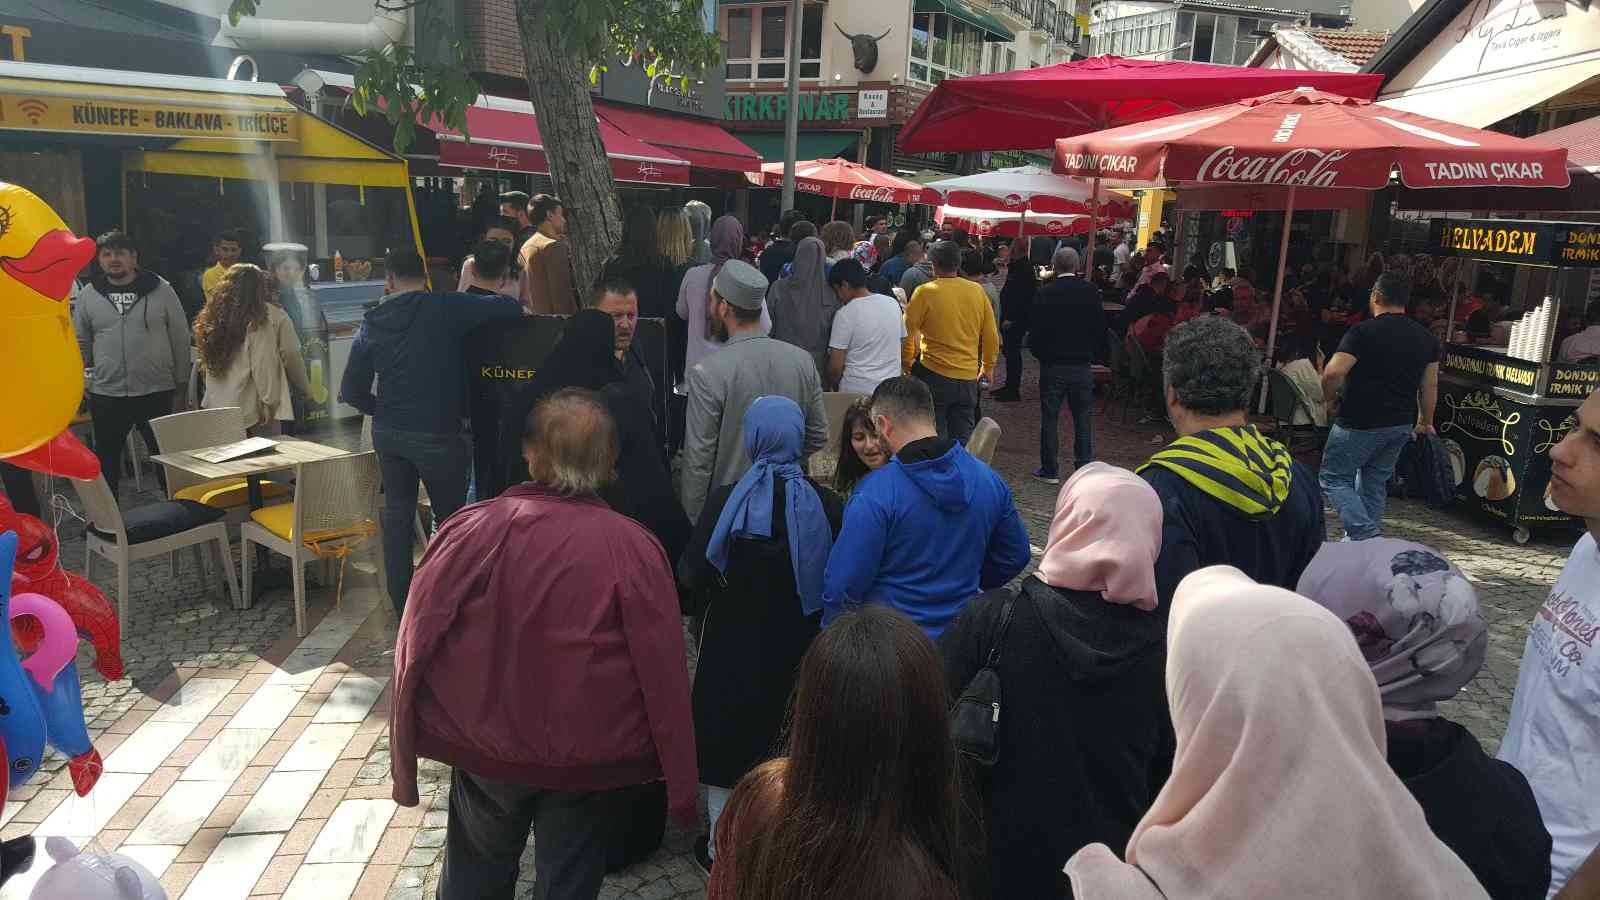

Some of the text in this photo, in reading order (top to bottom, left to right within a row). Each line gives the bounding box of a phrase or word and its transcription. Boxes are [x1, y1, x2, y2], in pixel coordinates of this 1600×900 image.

[71, 102, 139, 128] KÜNEFE
[155, 110, 223, 131] BAKLAVA
[722, 95, 849, 121] KIRKPNAR
[1064, 153, 1098, 169] TADINI
[1196, 145, 1350, 187] Coca-Cola
[1424, 162, 1544, 183] TADINI ÇIKAR
[850, 184, 895, 203] Coca-Cola
[1440, 226, 1537, 255] HELVADEM
